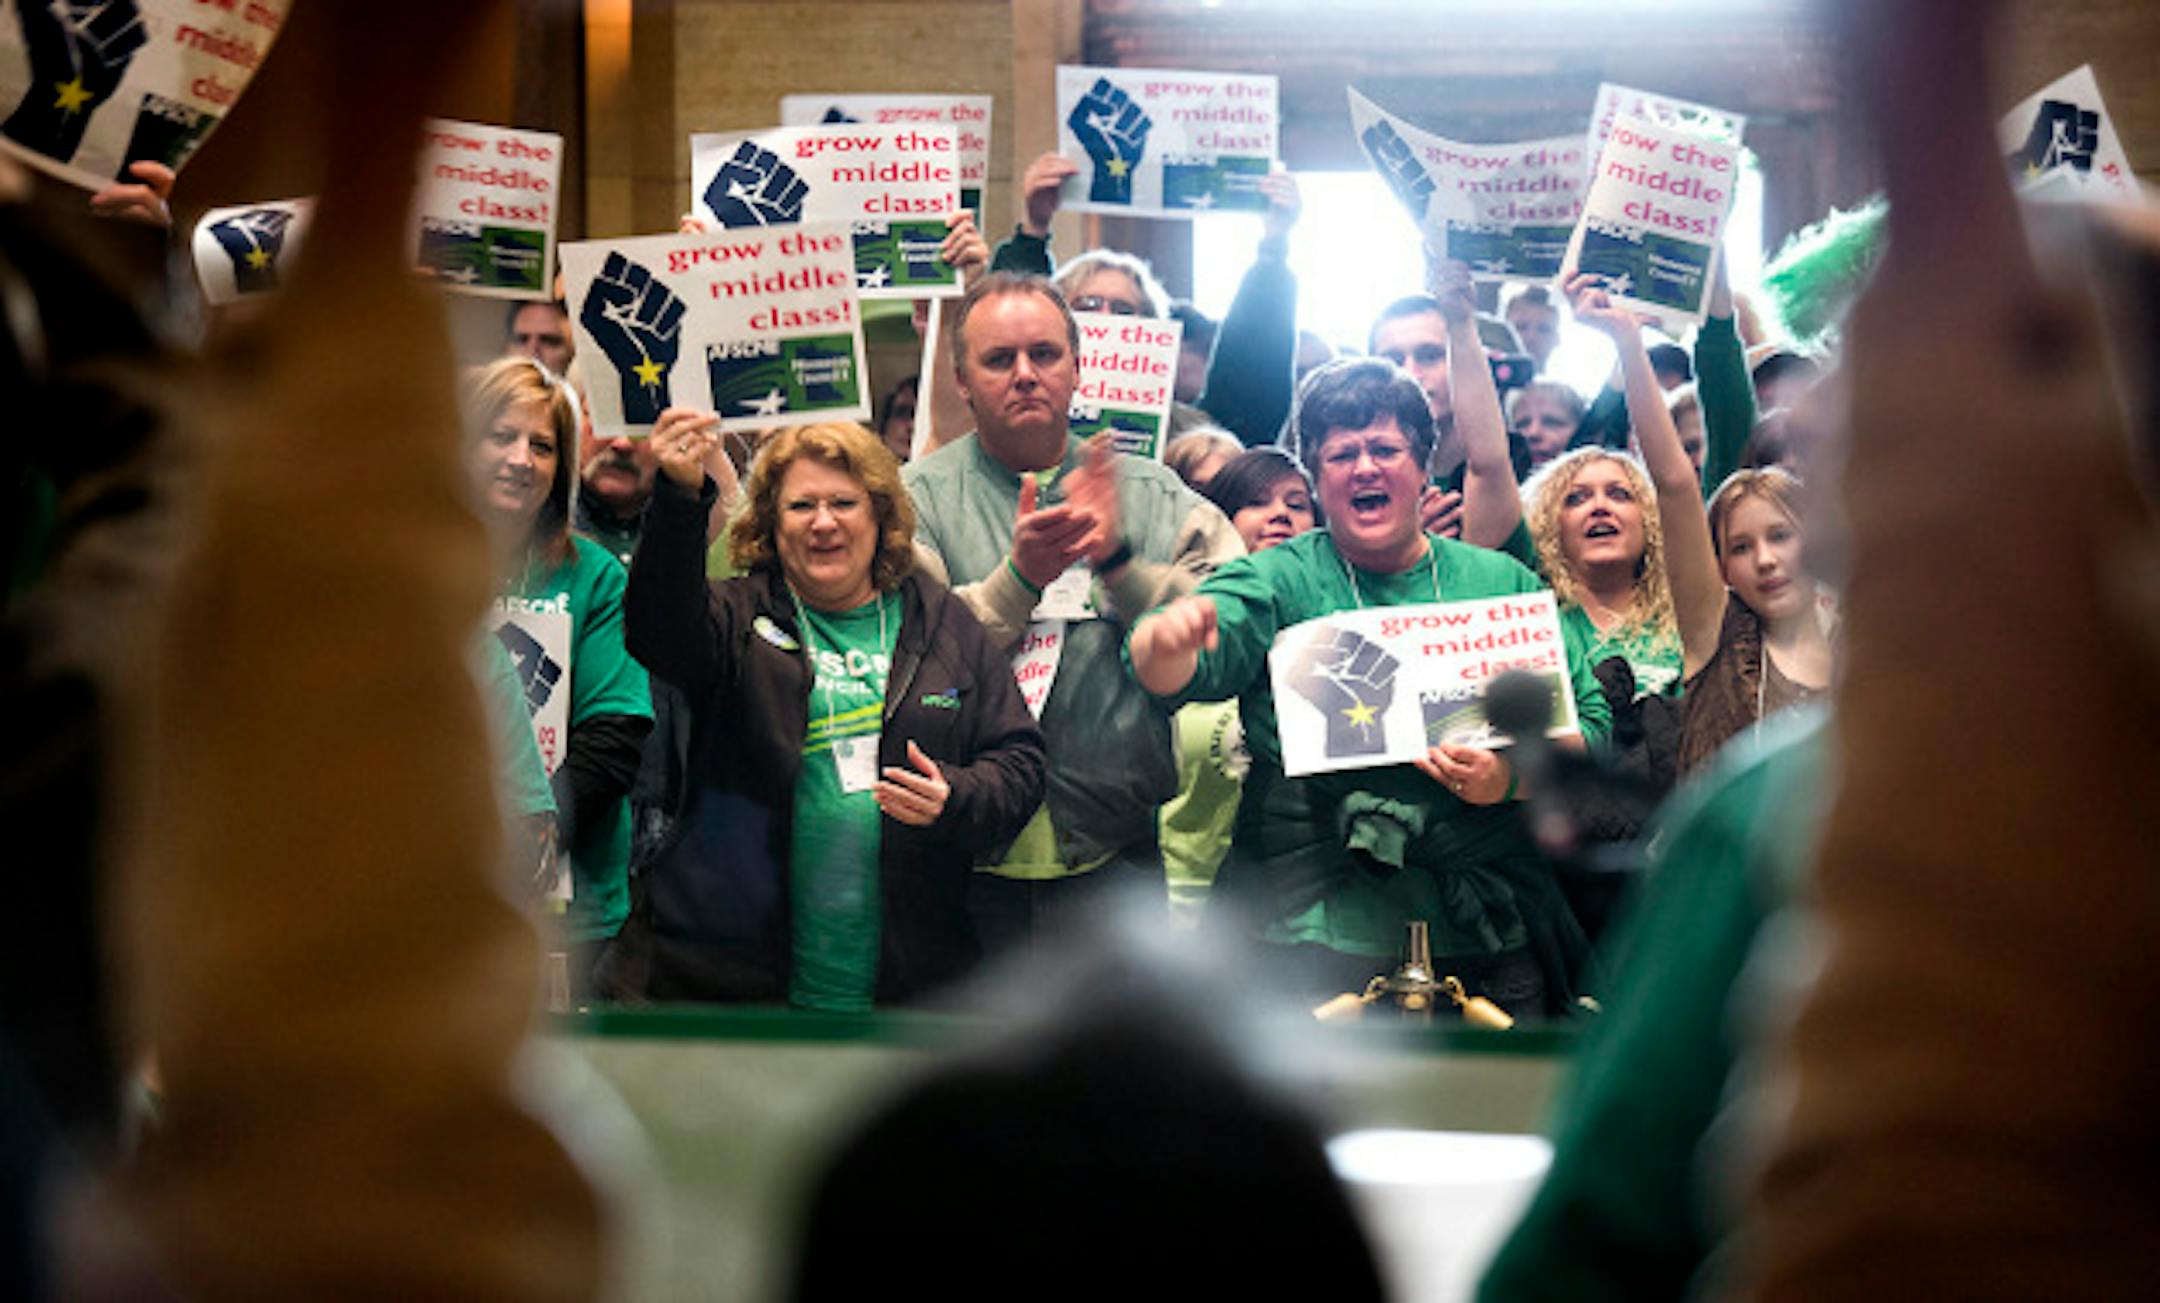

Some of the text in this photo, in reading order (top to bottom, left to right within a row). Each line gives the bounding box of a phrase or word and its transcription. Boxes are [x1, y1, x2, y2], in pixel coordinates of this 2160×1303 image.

[1144, 82, 1271, 98] grow the
[951, 102, 985, 122] the
[1172, 106, 1271, 123] middle
[431, 133, 552, 162] row the
[796, 131, 951, 158] grow the
[1196, 131, 1271, 149] class!
[1611, 128, 1730, 172] row the
[832, 161, 952, 182] middle
[1426, 147, 1581, 169] grow the
[434, 164, 550, 192] middle
[1457, 174, 1581, 193] middle
[1607, 161, 1722, 202] middle
[458, 196, 549, 223] class!
[863, 192, 954, 213] class!
[1487, 199, 1582, 219] class!
[1624, 201, 1718, 236] class!
[668, 232, 844, 272] grow the
[710, 266, 848, 299] middle
[749, 299, 851, 331] class!
[1120, 325, 1174, 346] the
[1079, 381, 1166, 405] class!
[1381, 603, 1548, 637] grow the
[1423, 628, 1554, 656] middle
